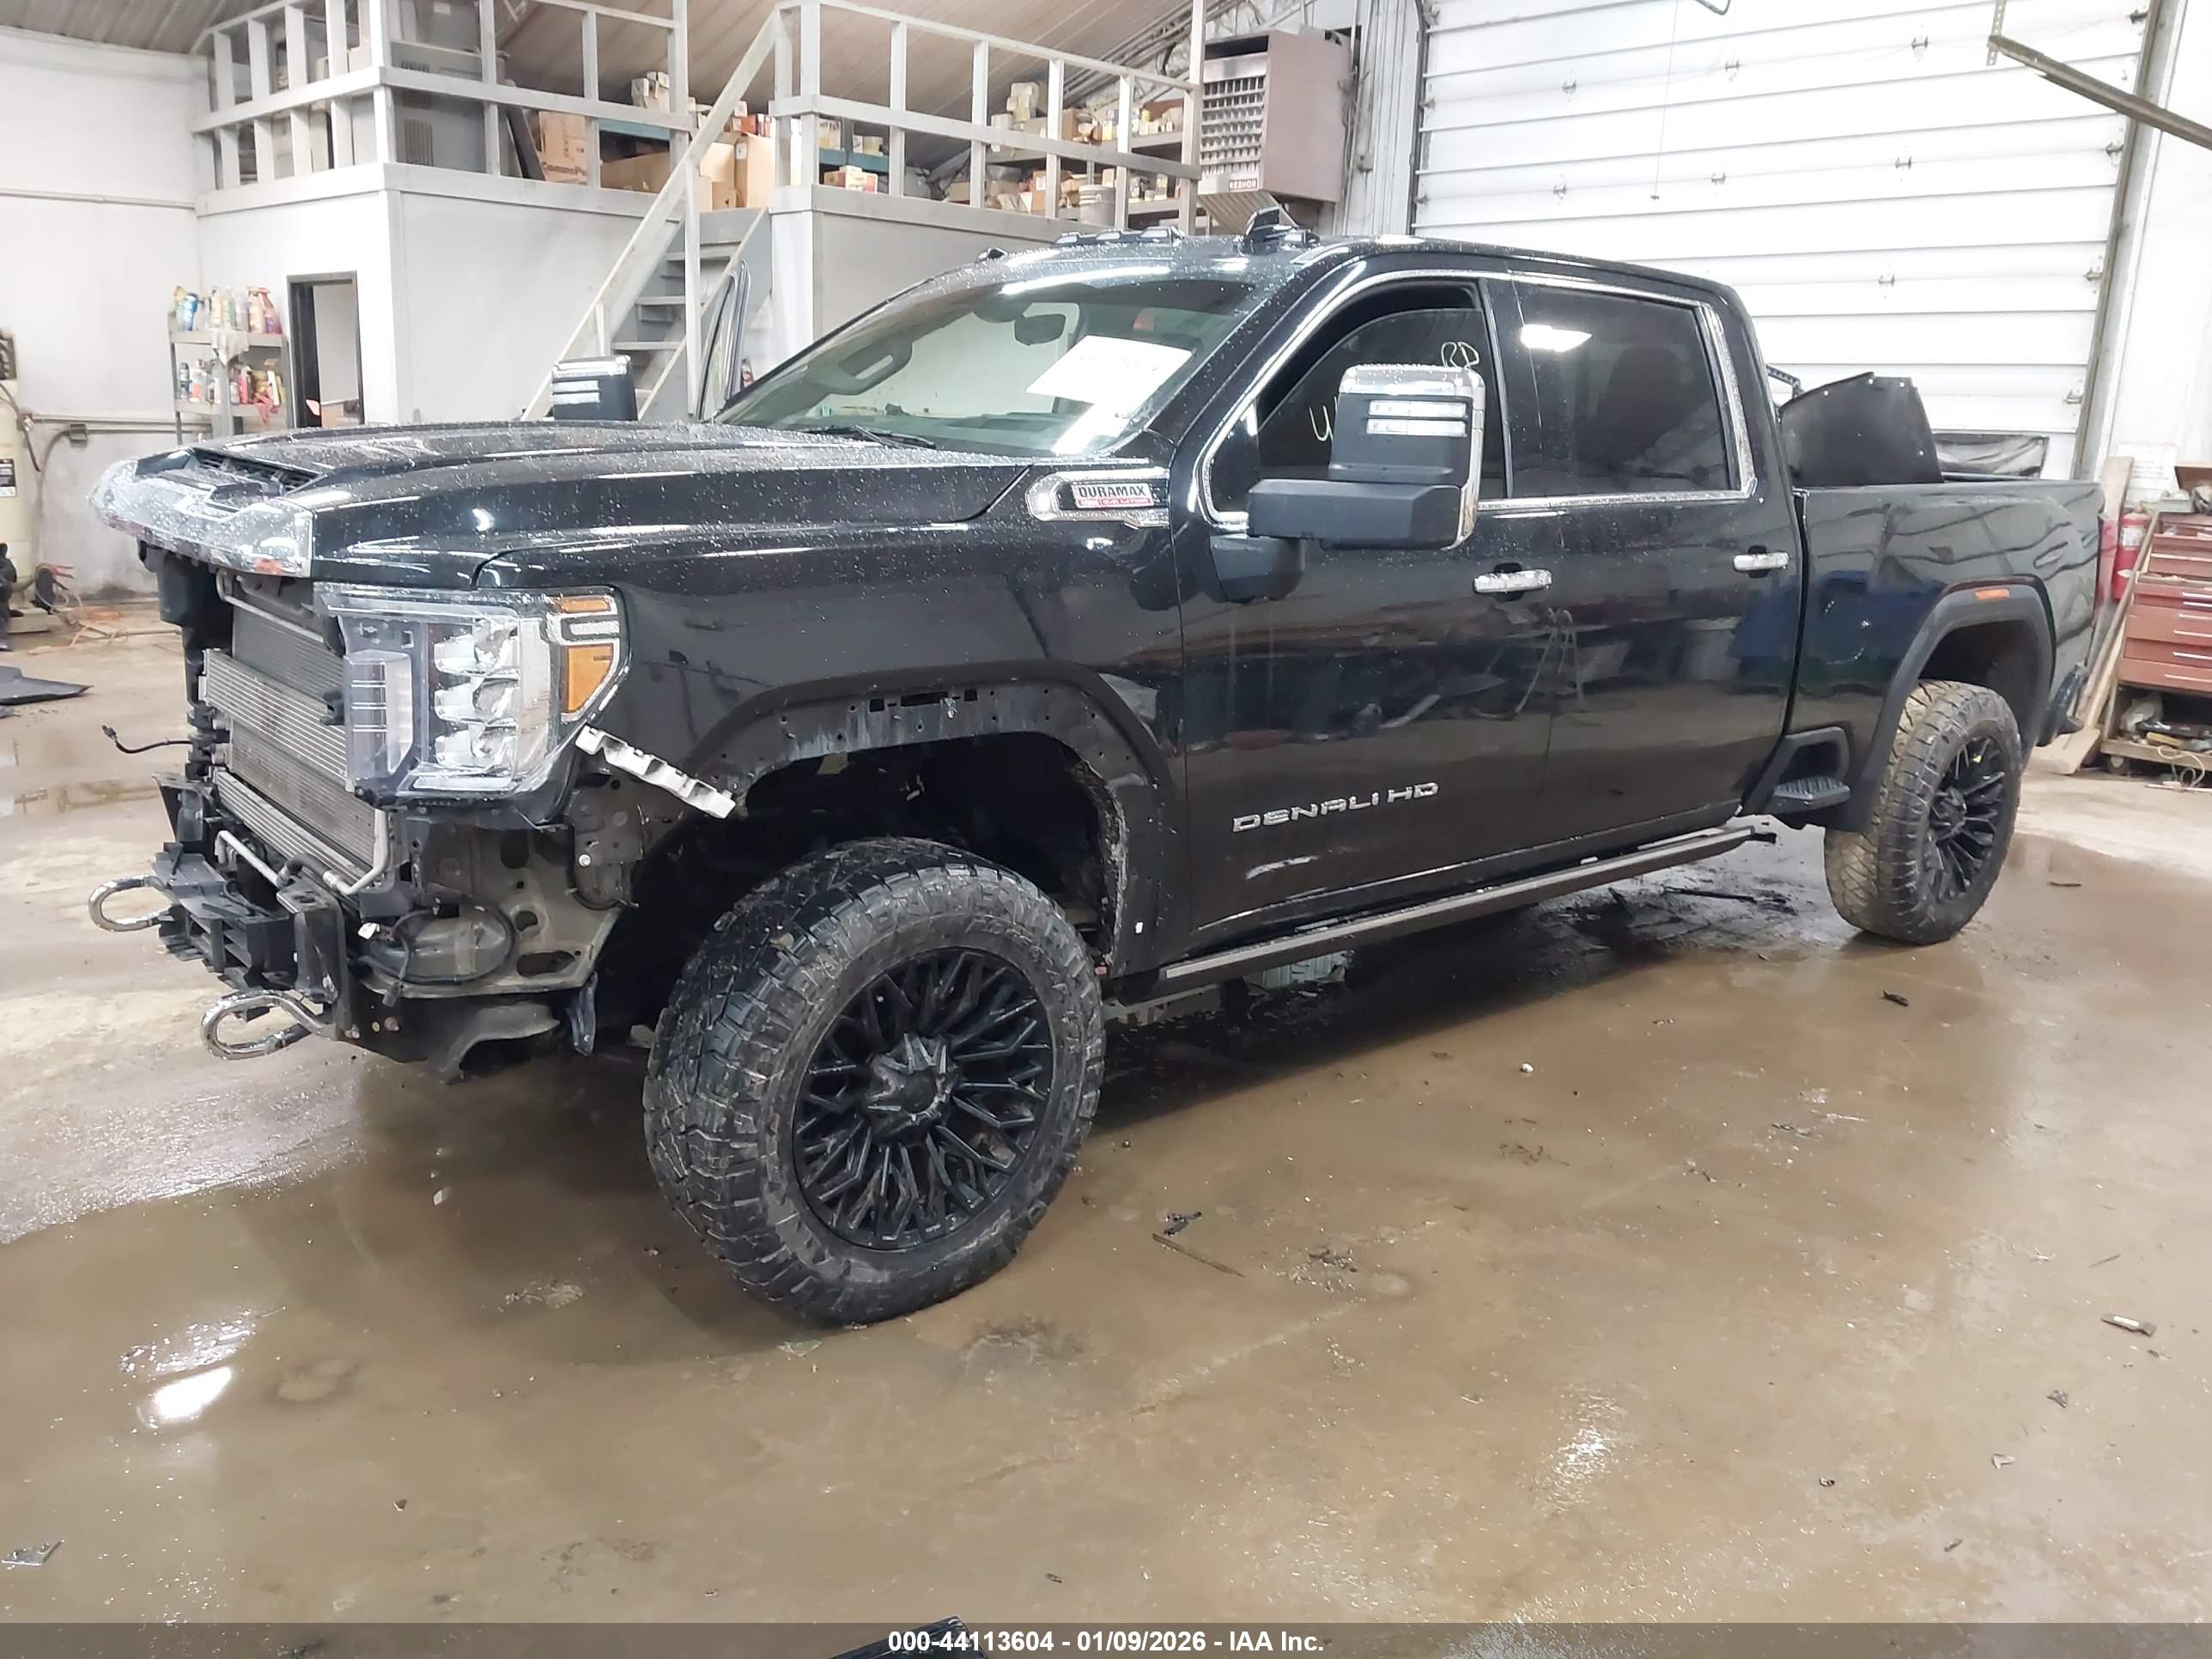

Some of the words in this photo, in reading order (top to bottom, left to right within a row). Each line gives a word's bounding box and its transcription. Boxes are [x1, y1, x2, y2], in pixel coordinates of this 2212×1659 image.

[1079, 485, 1146, 498] DURAMAX
[1232, 791, 1380, 832] DENALI
[1387, 781, 1439, 804] HD
